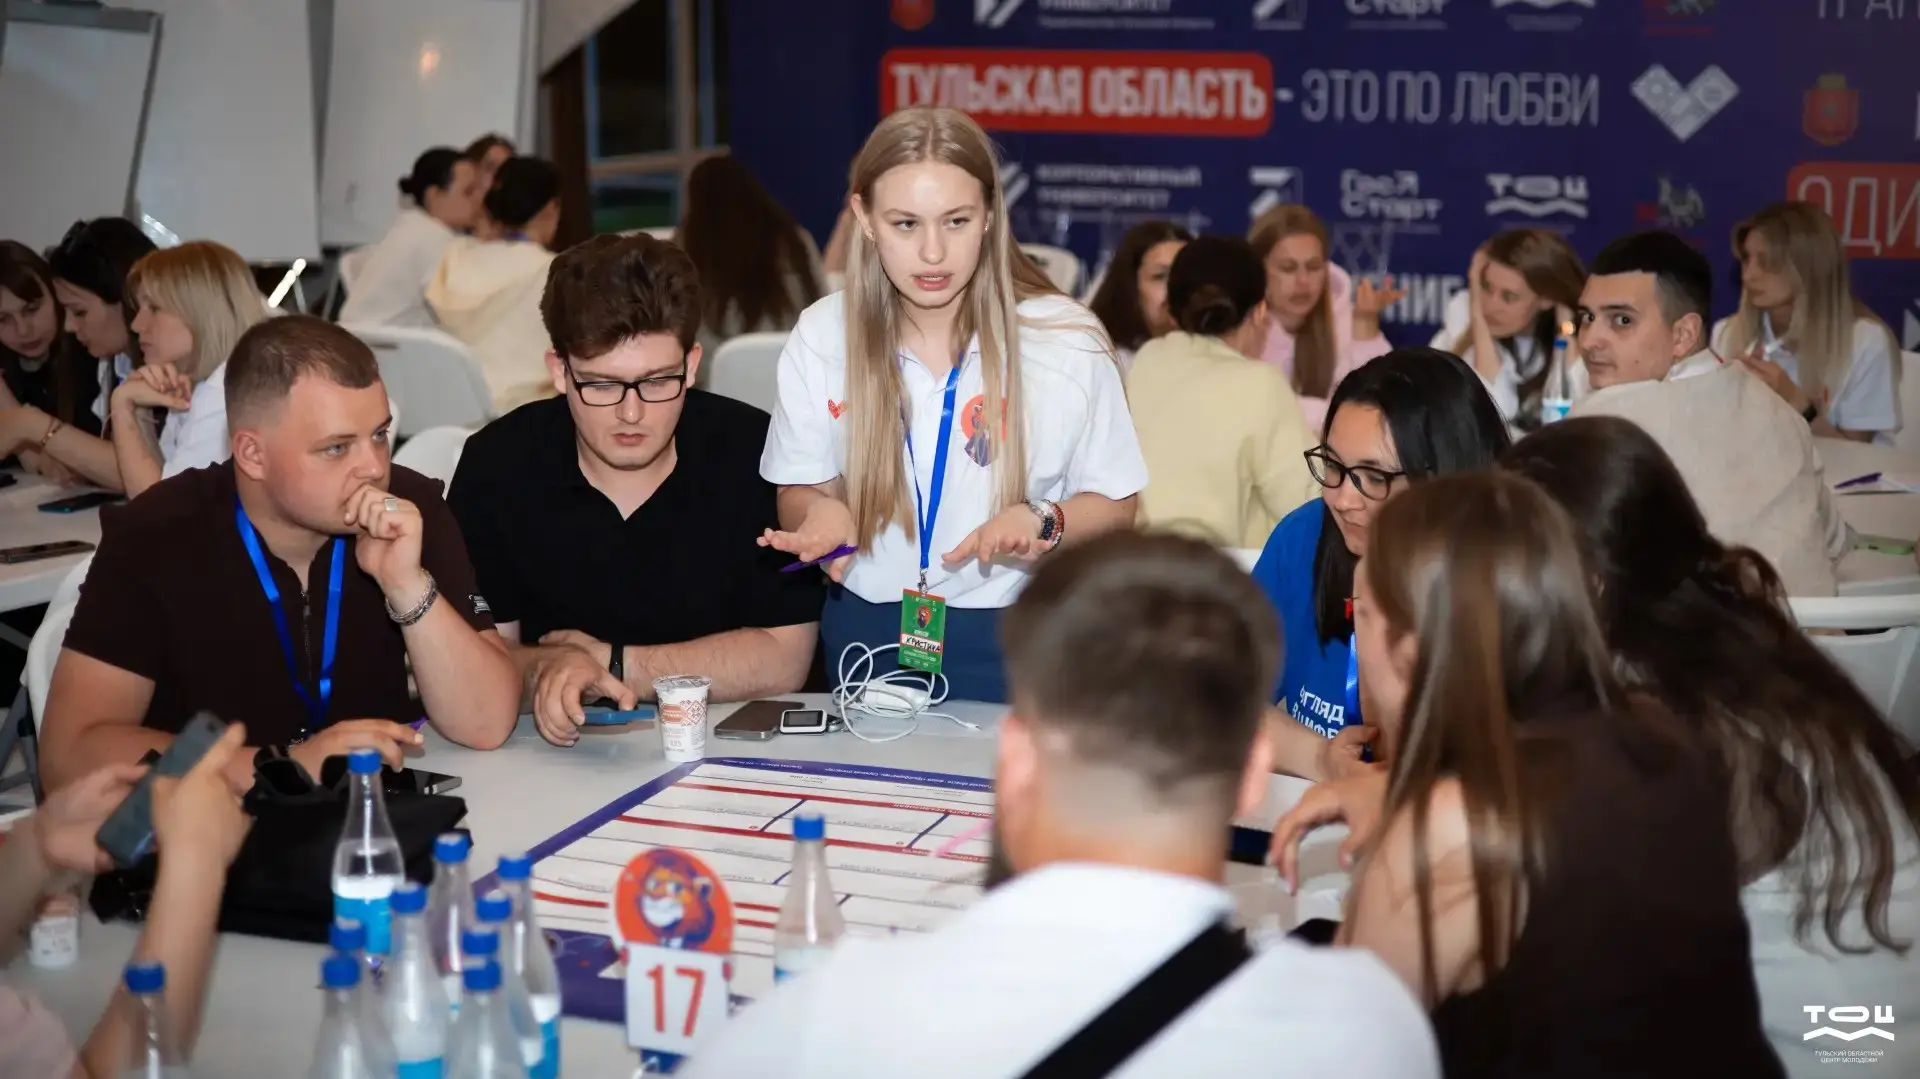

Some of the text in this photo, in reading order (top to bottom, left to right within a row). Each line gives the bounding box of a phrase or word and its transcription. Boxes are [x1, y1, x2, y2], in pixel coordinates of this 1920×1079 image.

[892, 63, 1082, 115] ТУЛЬСКАЯ
[1089, 66, 1268, 120] ОБЛАСТЬ
[1301, 68, 1379, 122] ЭТО
[1386, 70, 1441, 124] ПО
[1450, 71, 1600, 127] ЛЮБВИ
[1300, 685, 1344, 726] ГЛЯД
[646, 962, 706, 1038] 17
